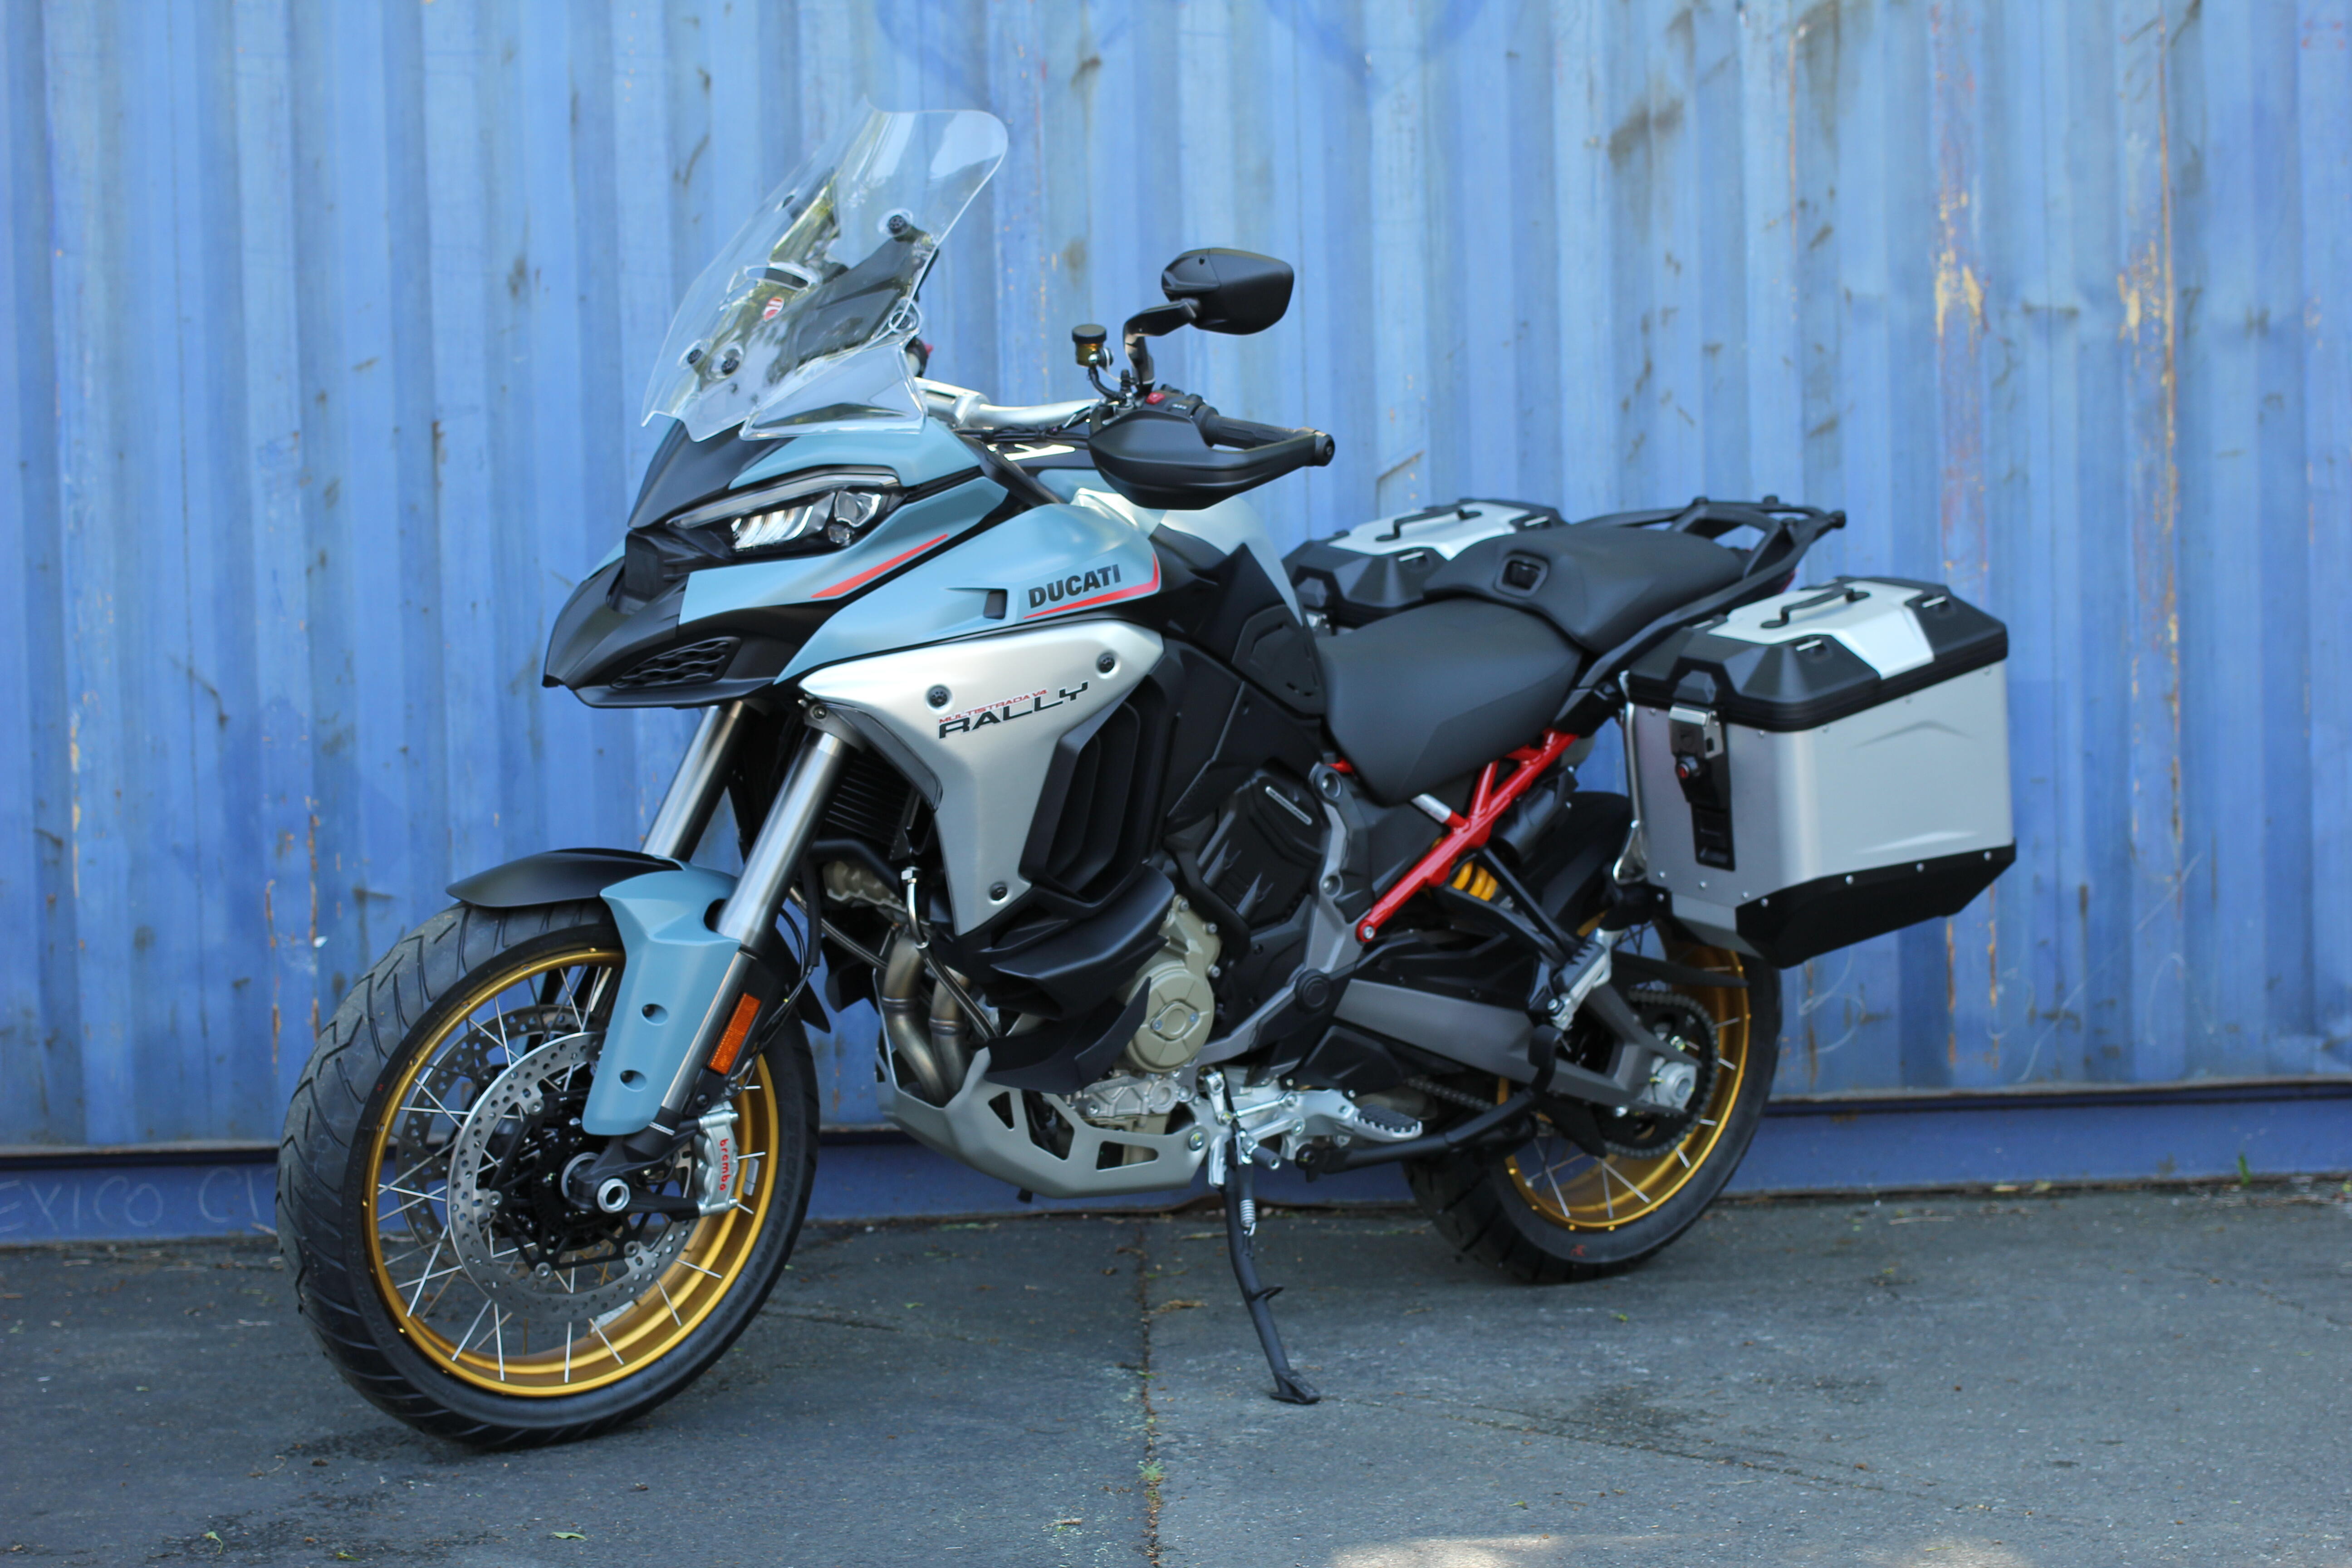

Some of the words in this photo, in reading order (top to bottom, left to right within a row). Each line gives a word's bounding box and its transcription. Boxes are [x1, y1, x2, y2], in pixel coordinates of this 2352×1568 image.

[1029, 564, 1121, 608] DUCATI
[939, 695, 1030, 724] MULTISTRADA
[939, 681, 1088, 739] RALLY
[719, 1138, 730, 1191] brembo
